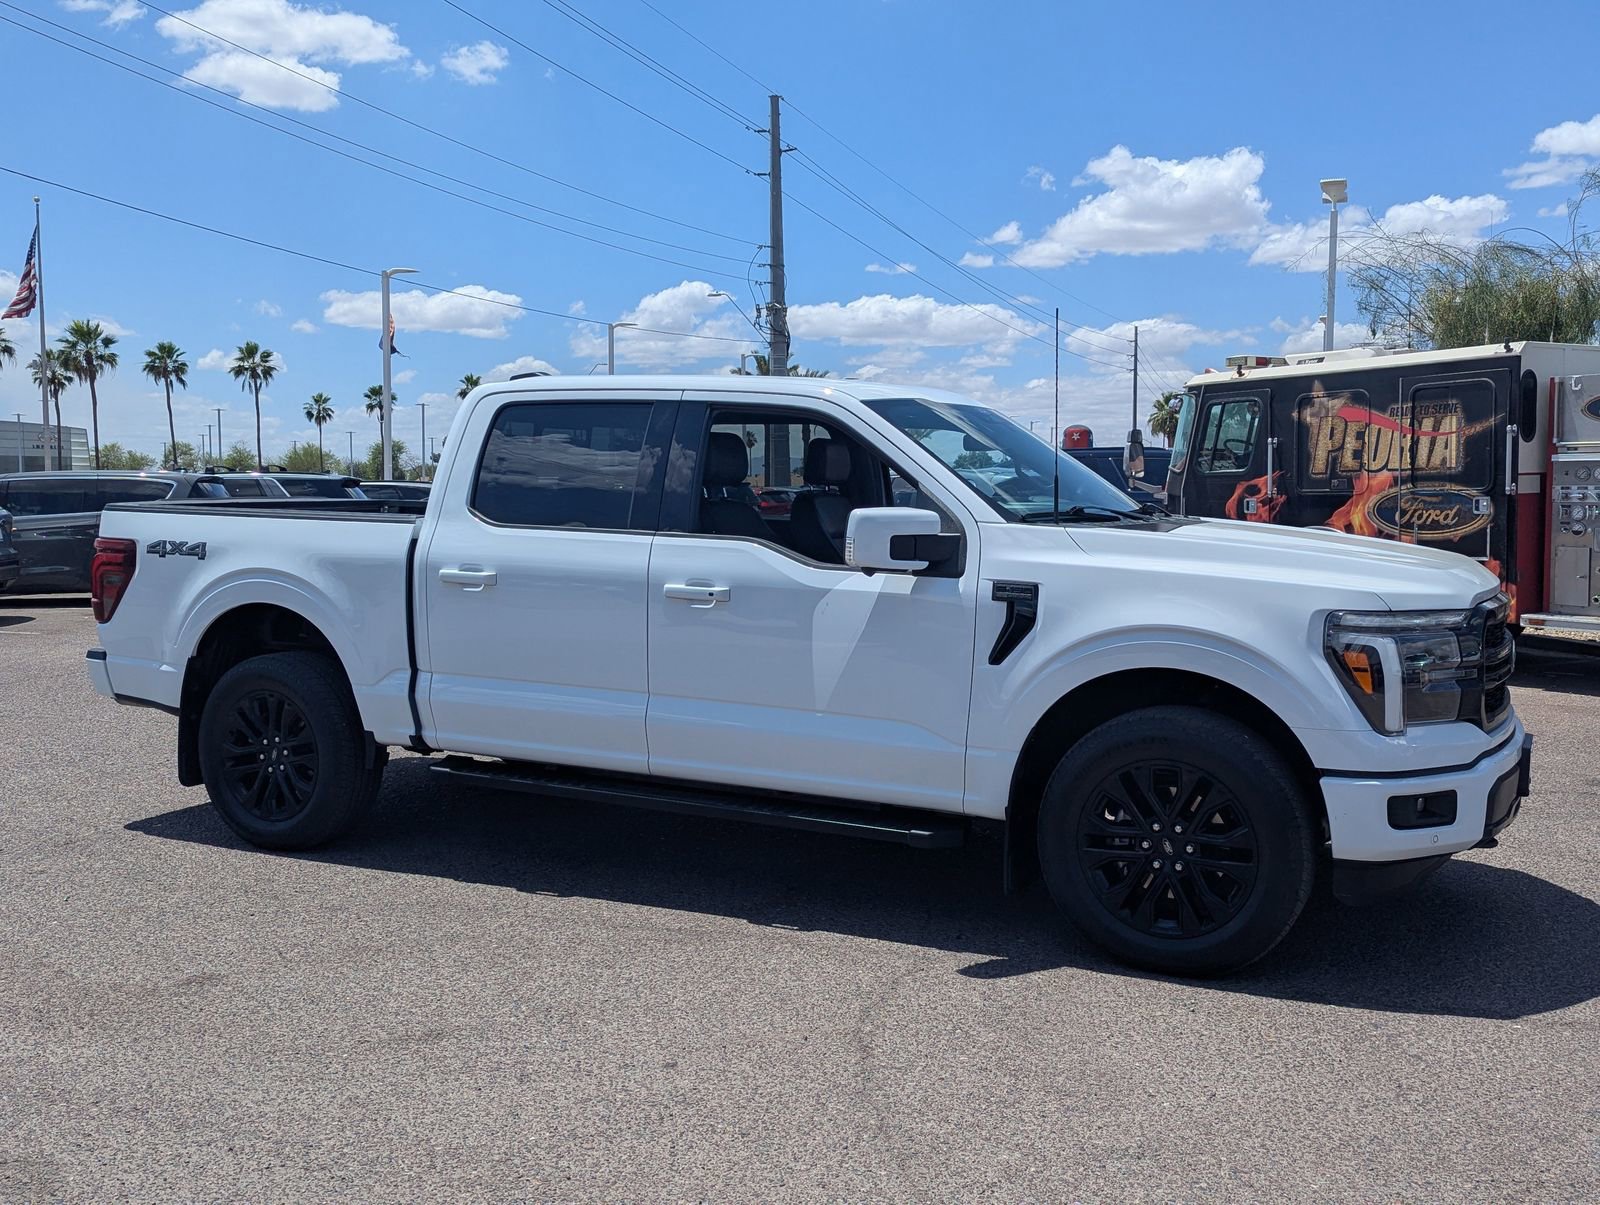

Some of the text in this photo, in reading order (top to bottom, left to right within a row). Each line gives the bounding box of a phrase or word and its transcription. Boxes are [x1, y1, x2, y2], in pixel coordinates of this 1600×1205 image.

[1389, 405, 1417, 418] READ
[1419, 403, 1430, 416] TO
[1311, 415, 1458, 474] PEORIA
[1395, 495, 1460, 526] Ford
